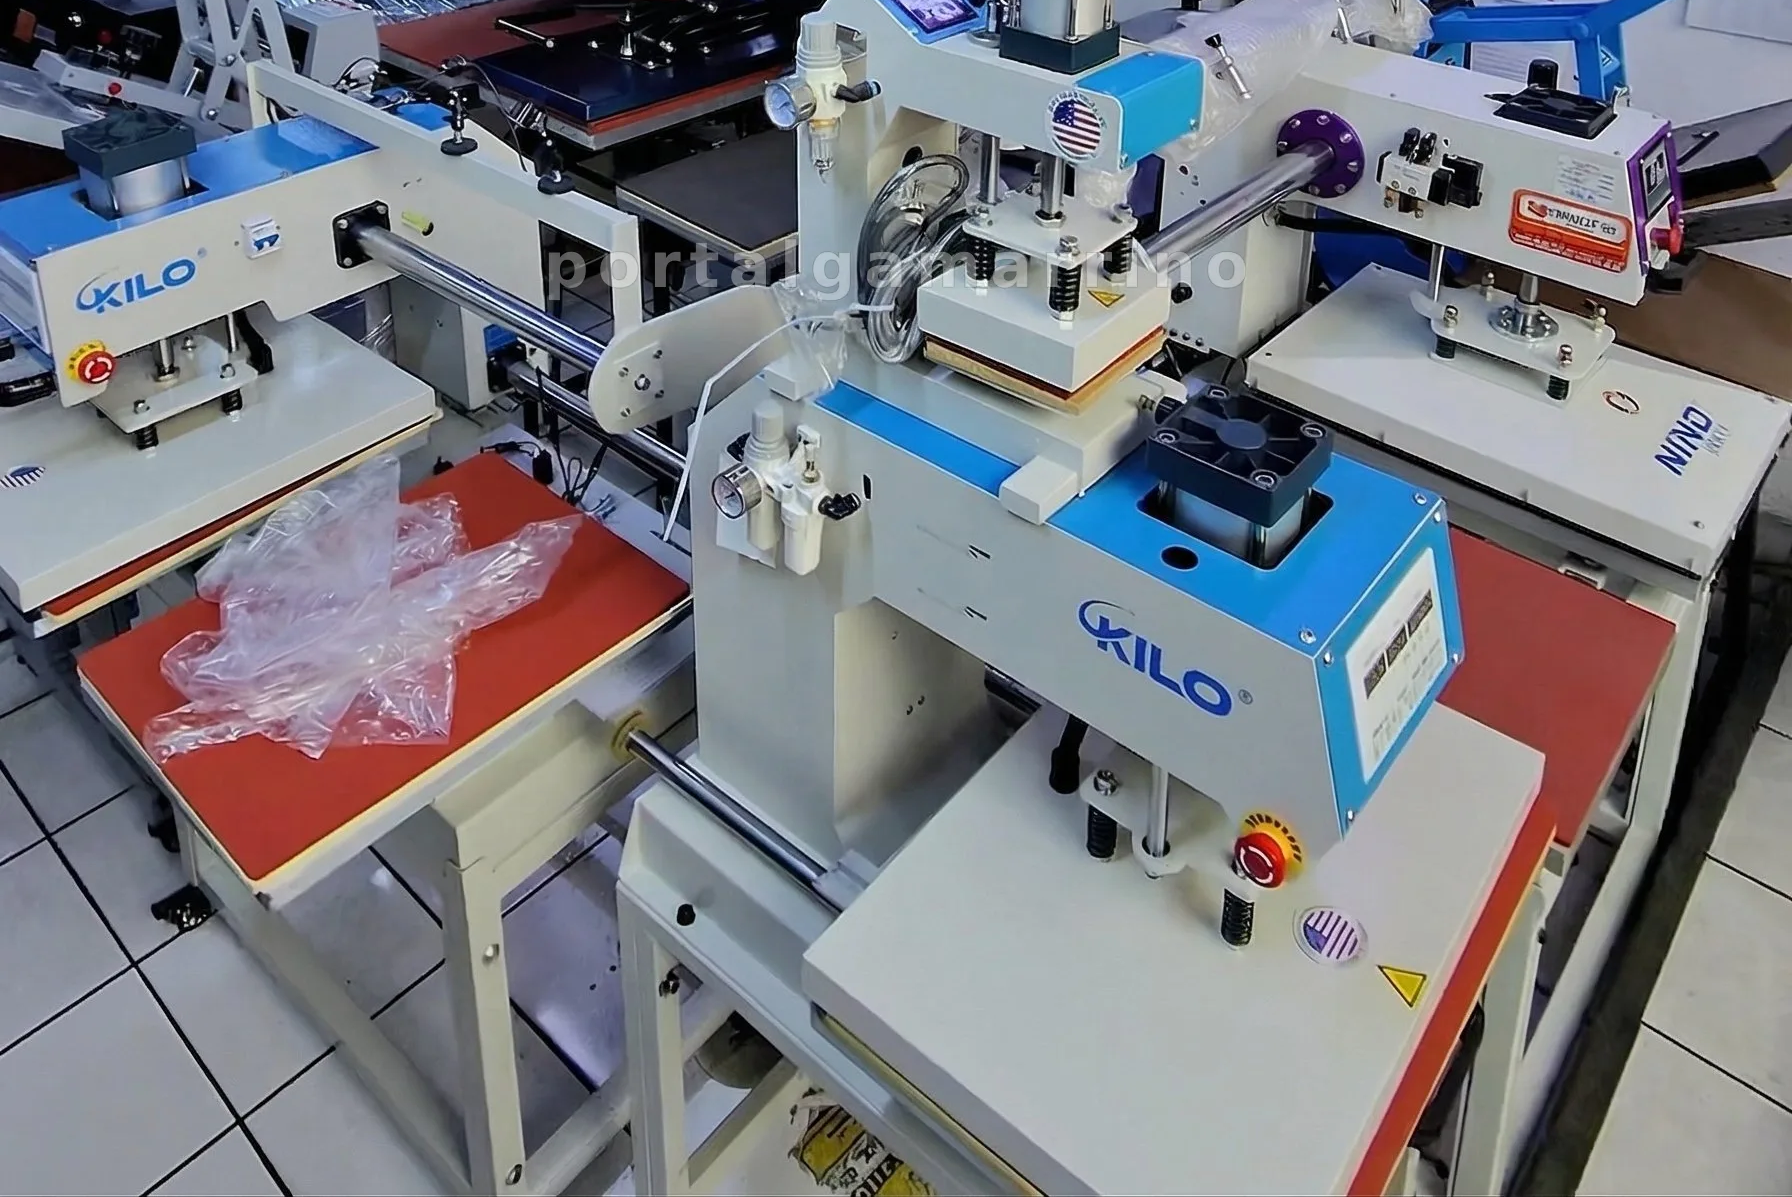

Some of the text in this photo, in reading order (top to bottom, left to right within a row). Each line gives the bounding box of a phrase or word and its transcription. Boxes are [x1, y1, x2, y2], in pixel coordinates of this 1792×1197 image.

[76, 259, 196, 313] KILO
[1655, 406, 1713, 476] NINO
[1080, 601, 1233, 716] KILO
